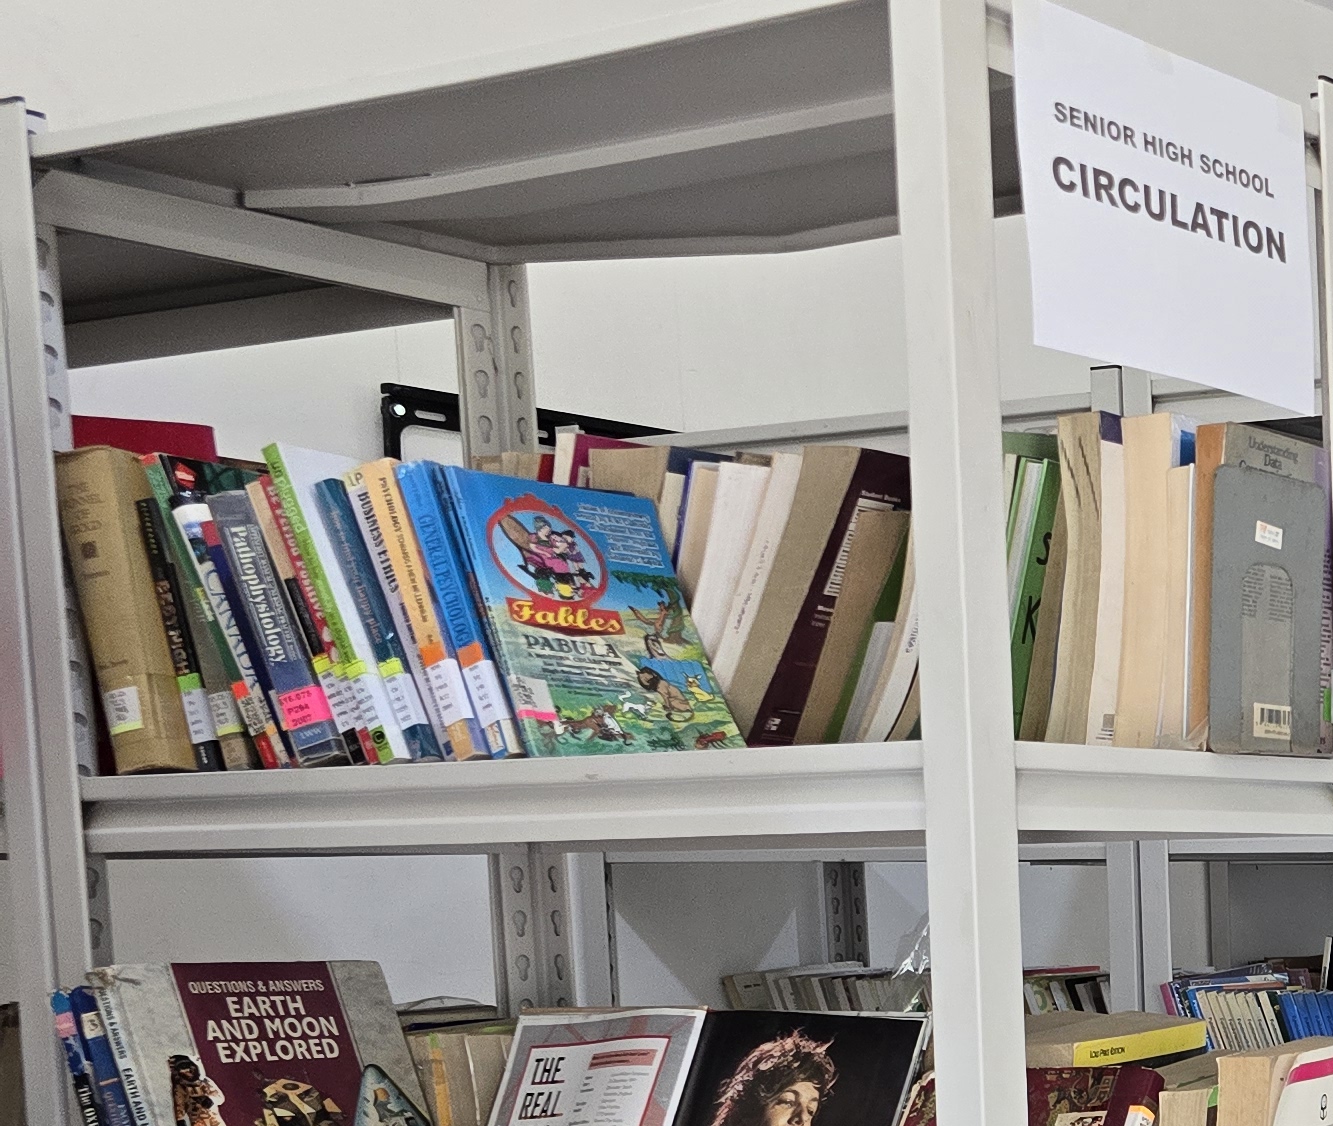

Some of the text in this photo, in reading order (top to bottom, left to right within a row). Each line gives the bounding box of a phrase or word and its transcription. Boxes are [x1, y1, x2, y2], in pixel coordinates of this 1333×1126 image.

[1054, 102, 1275, 199] SENIOR HIGH SCHOOL
[1052, 156, 1287, 264] CIRCULATION
[1248, 436, 1299, 464] Understanding
[1264, 454, 1283, 470] Data
[355, 490, 386, 548] BUSINESS
[414, 513, 447, 569] GENERAL
[227, 522, 290, 668] Pathophysiology
[353, 582, 386, 646] happy place
[512, 600, 622, 632] Fables
[188, 980, 325, 994] QUESTIONS & ANSWERS
[226, 995, 306, 1018] EARTH
[207, 1016, 339, 1041] AND MOON
[216, 1038, 340, 1064] EXPLORED
[531, 1057, 566, 1083] THE
[122, 1066, 140, 1099] EARTH
[132, 1098, 147, 1120] AND
[519, 1091, 563, 1119] REAL
